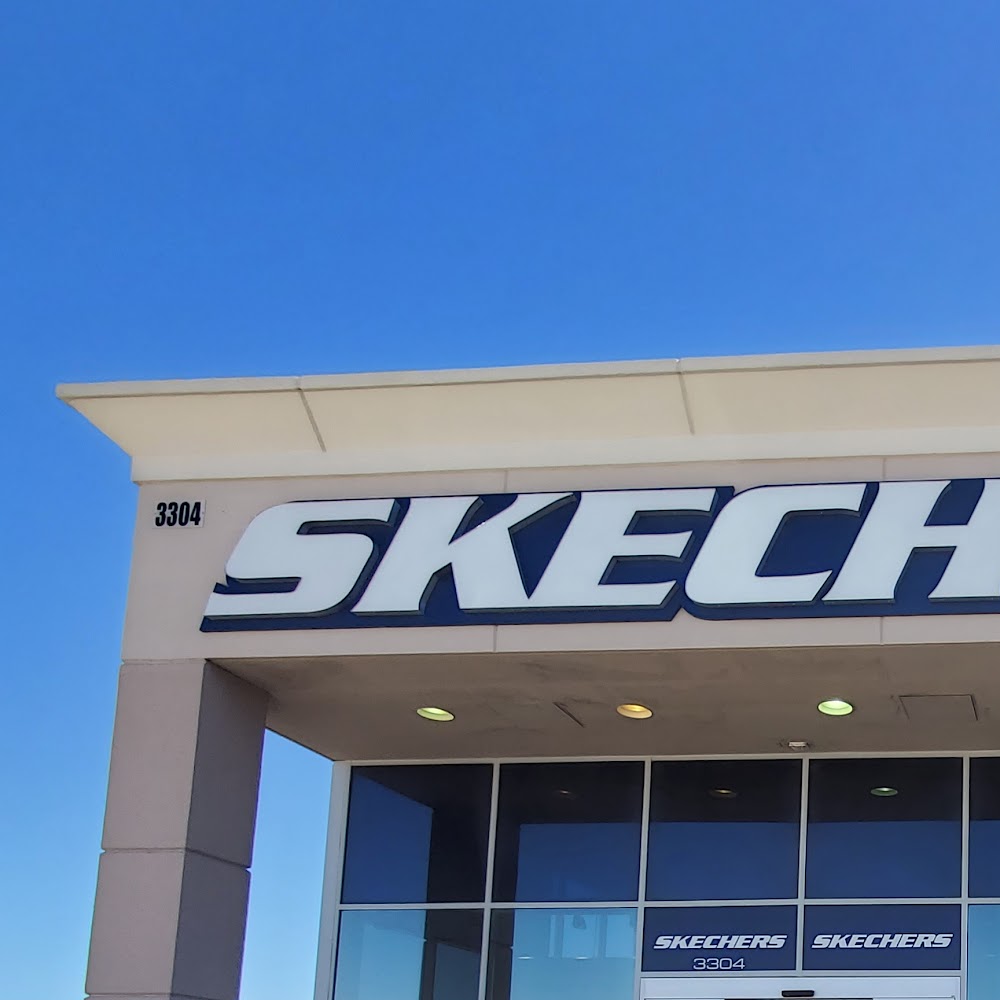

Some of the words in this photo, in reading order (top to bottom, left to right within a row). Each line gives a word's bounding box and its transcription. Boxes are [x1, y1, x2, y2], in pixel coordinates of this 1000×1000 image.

[155, 502, 201, 527] 3304
[653, 935, 788, 949] SKECHERS
[811, 933, 954, 948] SKECHERS
[693, 957, 746, 970] 3304
